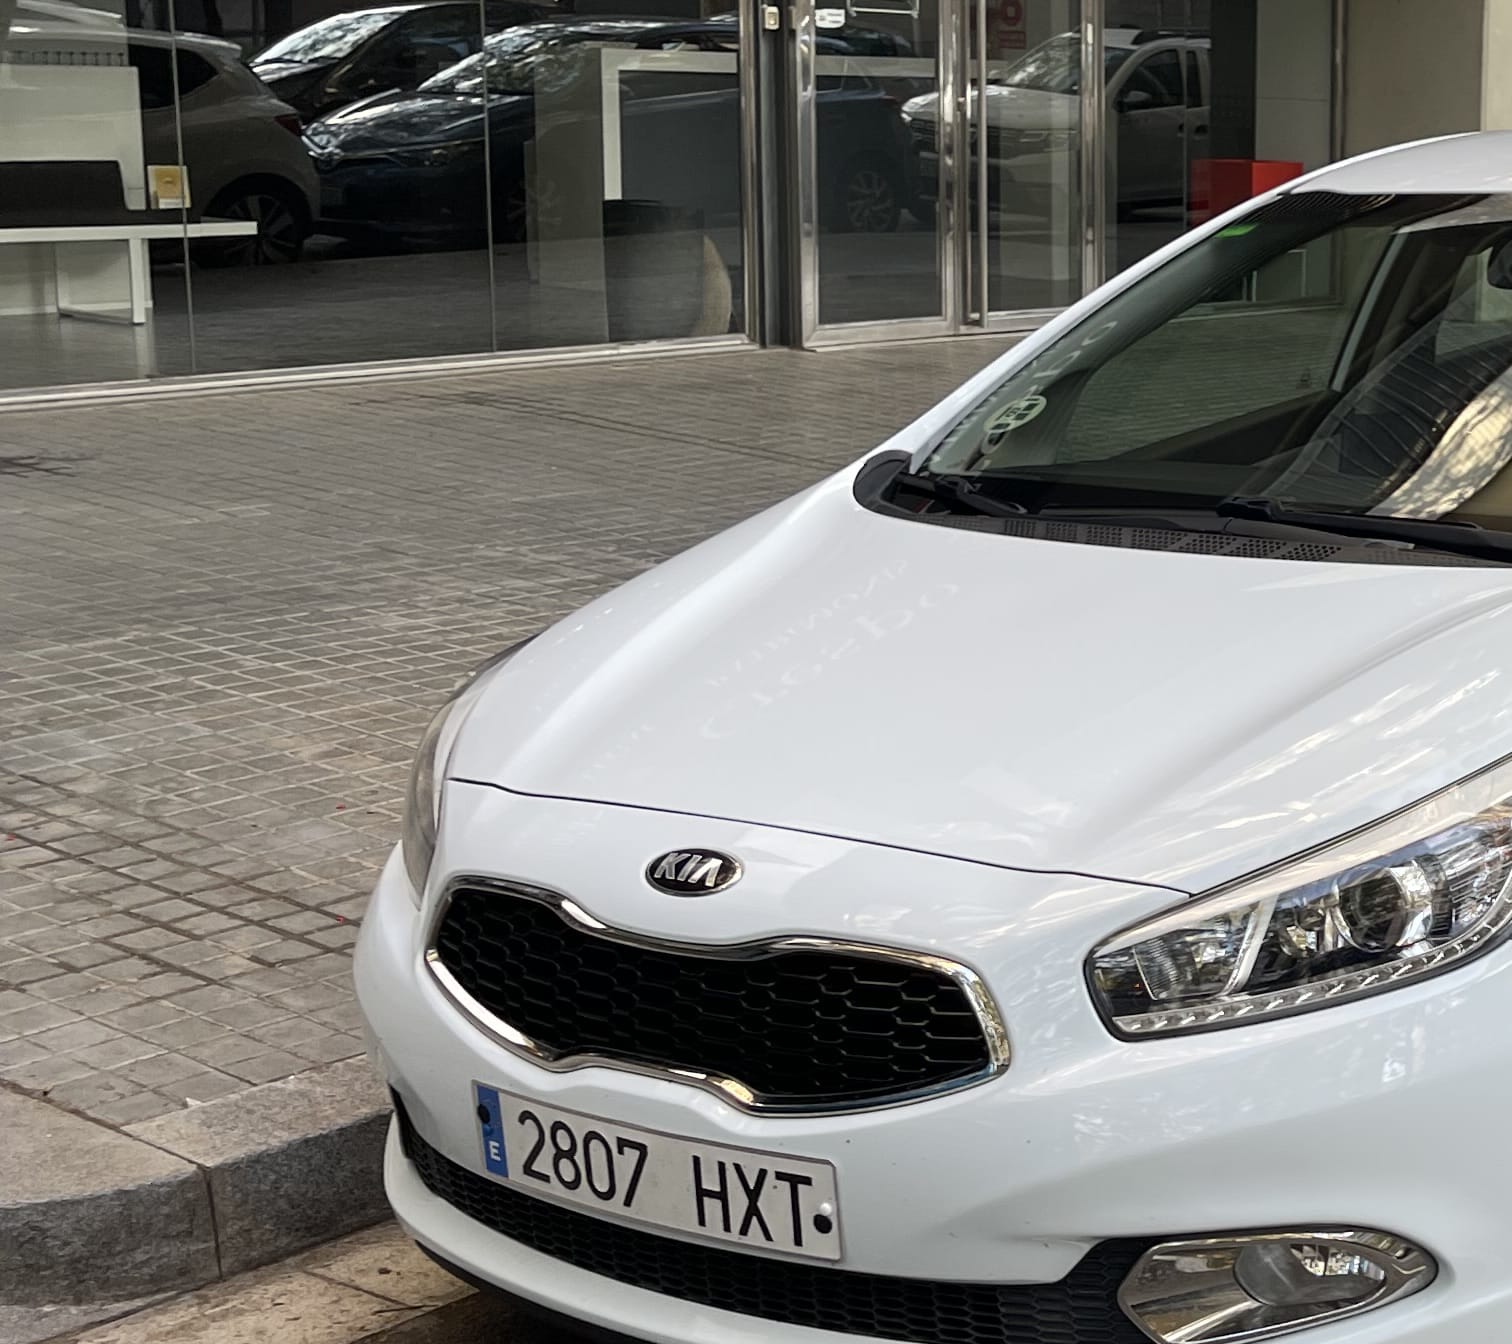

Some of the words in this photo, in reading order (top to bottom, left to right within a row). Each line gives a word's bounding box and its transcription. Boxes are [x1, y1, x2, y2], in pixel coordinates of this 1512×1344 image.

[652, 851, 725, 888] KIA
[488, 1140, 502, 1162] E
[516, 1109, 649, 1208] 2807
[692, 1154, 814, 1248] HXT
